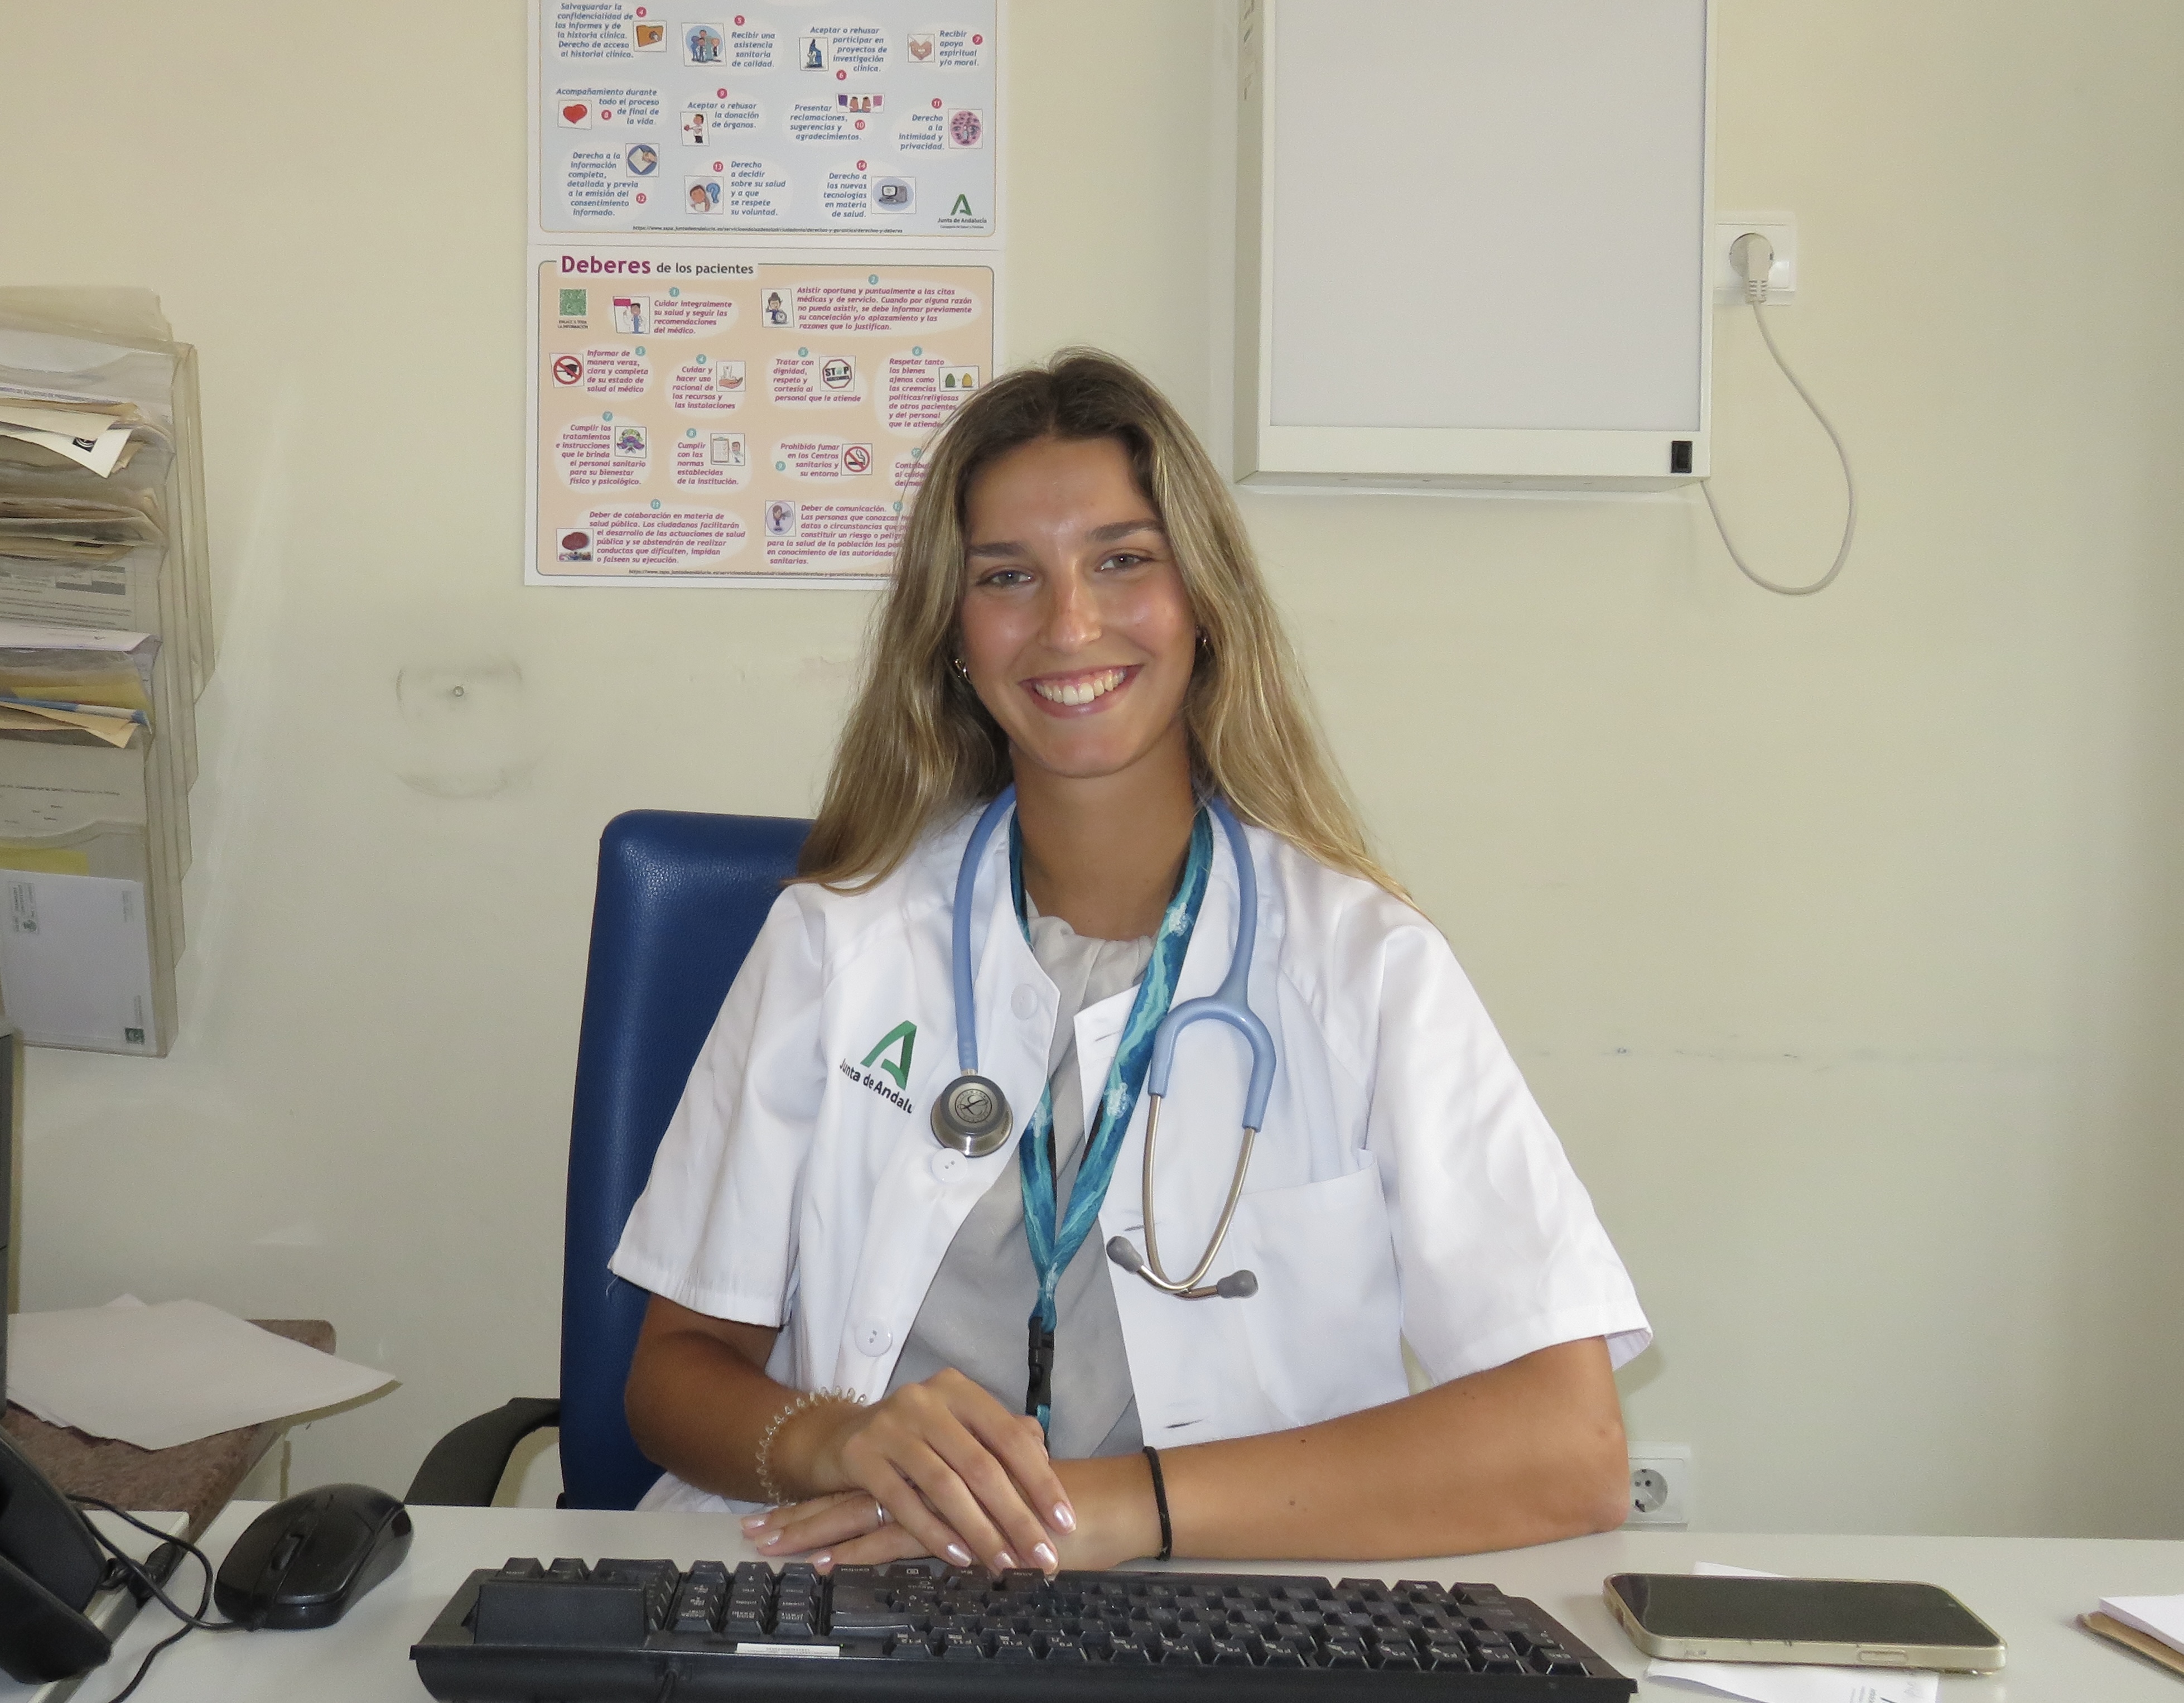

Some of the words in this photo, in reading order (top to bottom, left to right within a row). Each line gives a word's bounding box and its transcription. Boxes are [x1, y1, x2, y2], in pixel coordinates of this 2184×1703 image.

[833, 36, 872, 45] participar
[939, 49, 977, 57] espiritual
[833, 55, 884, 63] investigación
[724, 121, 756, 129] órganos.
[796, 133, 862, 141] agradecimientos.
[823, 191, 867, 200] tecnologías
[562, 255, 651, 274] Deberes
[657, 262, 671, 273] de
[676, 262, 692, 273] los
[697, 263, 754, 276] pacientes
[598, 478, 642, 486] psicológico.
[840, 1058, 861, 1082] Junta
[863, 1073, 874, 1089] de
